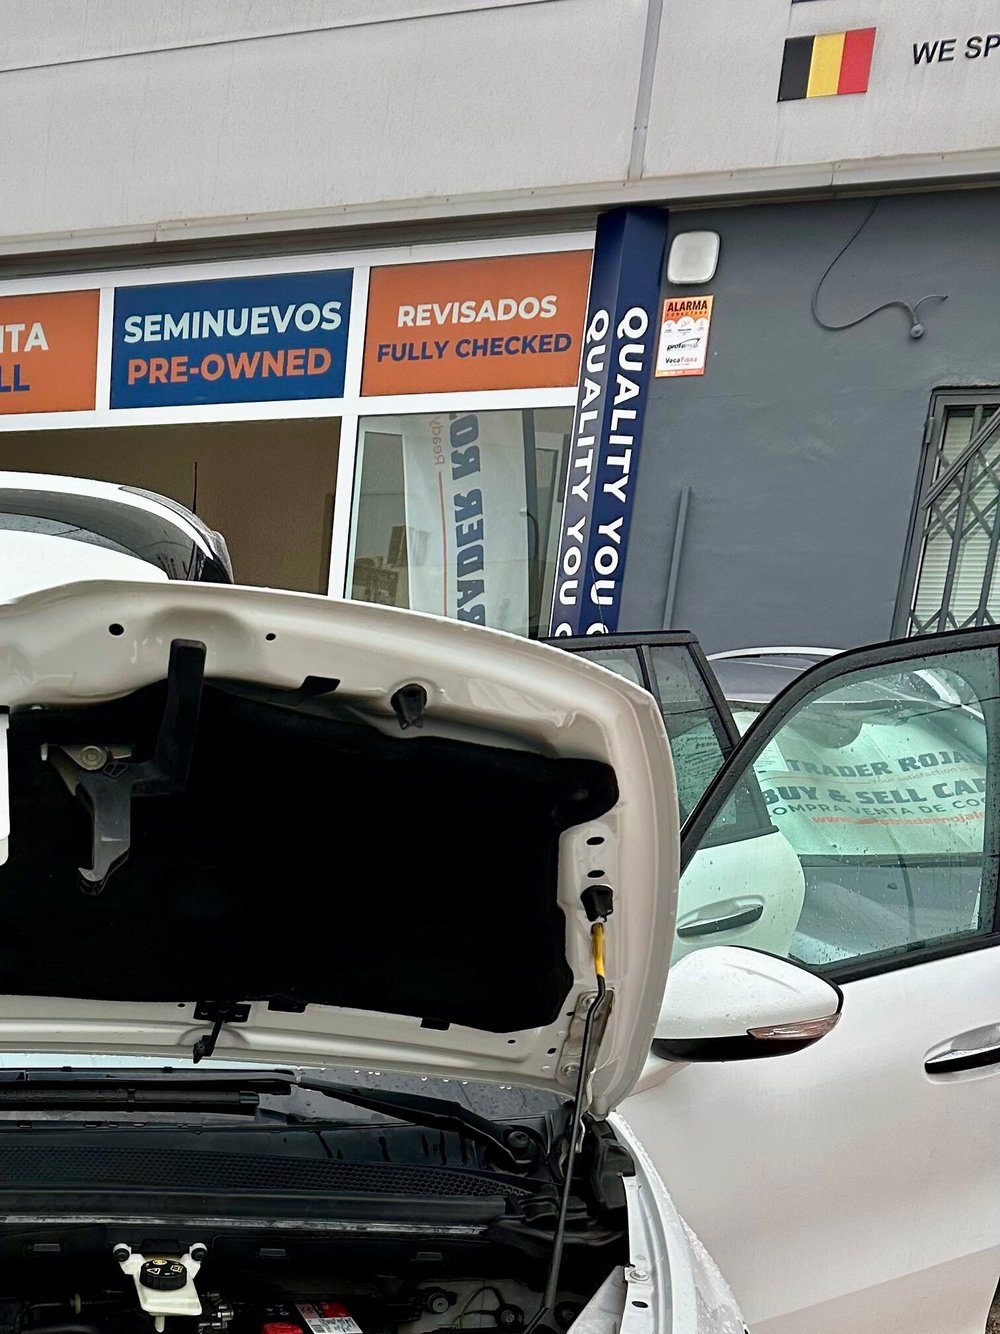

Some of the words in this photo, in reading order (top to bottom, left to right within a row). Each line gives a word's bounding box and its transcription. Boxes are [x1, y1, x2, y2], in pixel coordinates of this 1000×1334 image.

[912, 38, 957, 65] WE
[123, 301, 342, 343] SEMINUEVOS
[397, 295, 558, 328] REVISADOS
[667, 300, 708, 313] ALARMA
[377, 340, 449, 363] FULLY
[455, 333, 572, 357] CHECKED
[128, 347, 332, 386] PRE-OWNED
[571, 309, 610, 503] QUALITY
[602, 307, 649, 504] QUALITY
[559, 516, 587, 606] YOU
[590, 516, 625, 606] YOU
[786, 759, 893, 778] TRADER
[828, 789, 851, 803] &
[855, 788, 928, 805] SELL
[848, 805, 915, 816] VENTA
[918, 804, 947, 814] DE
